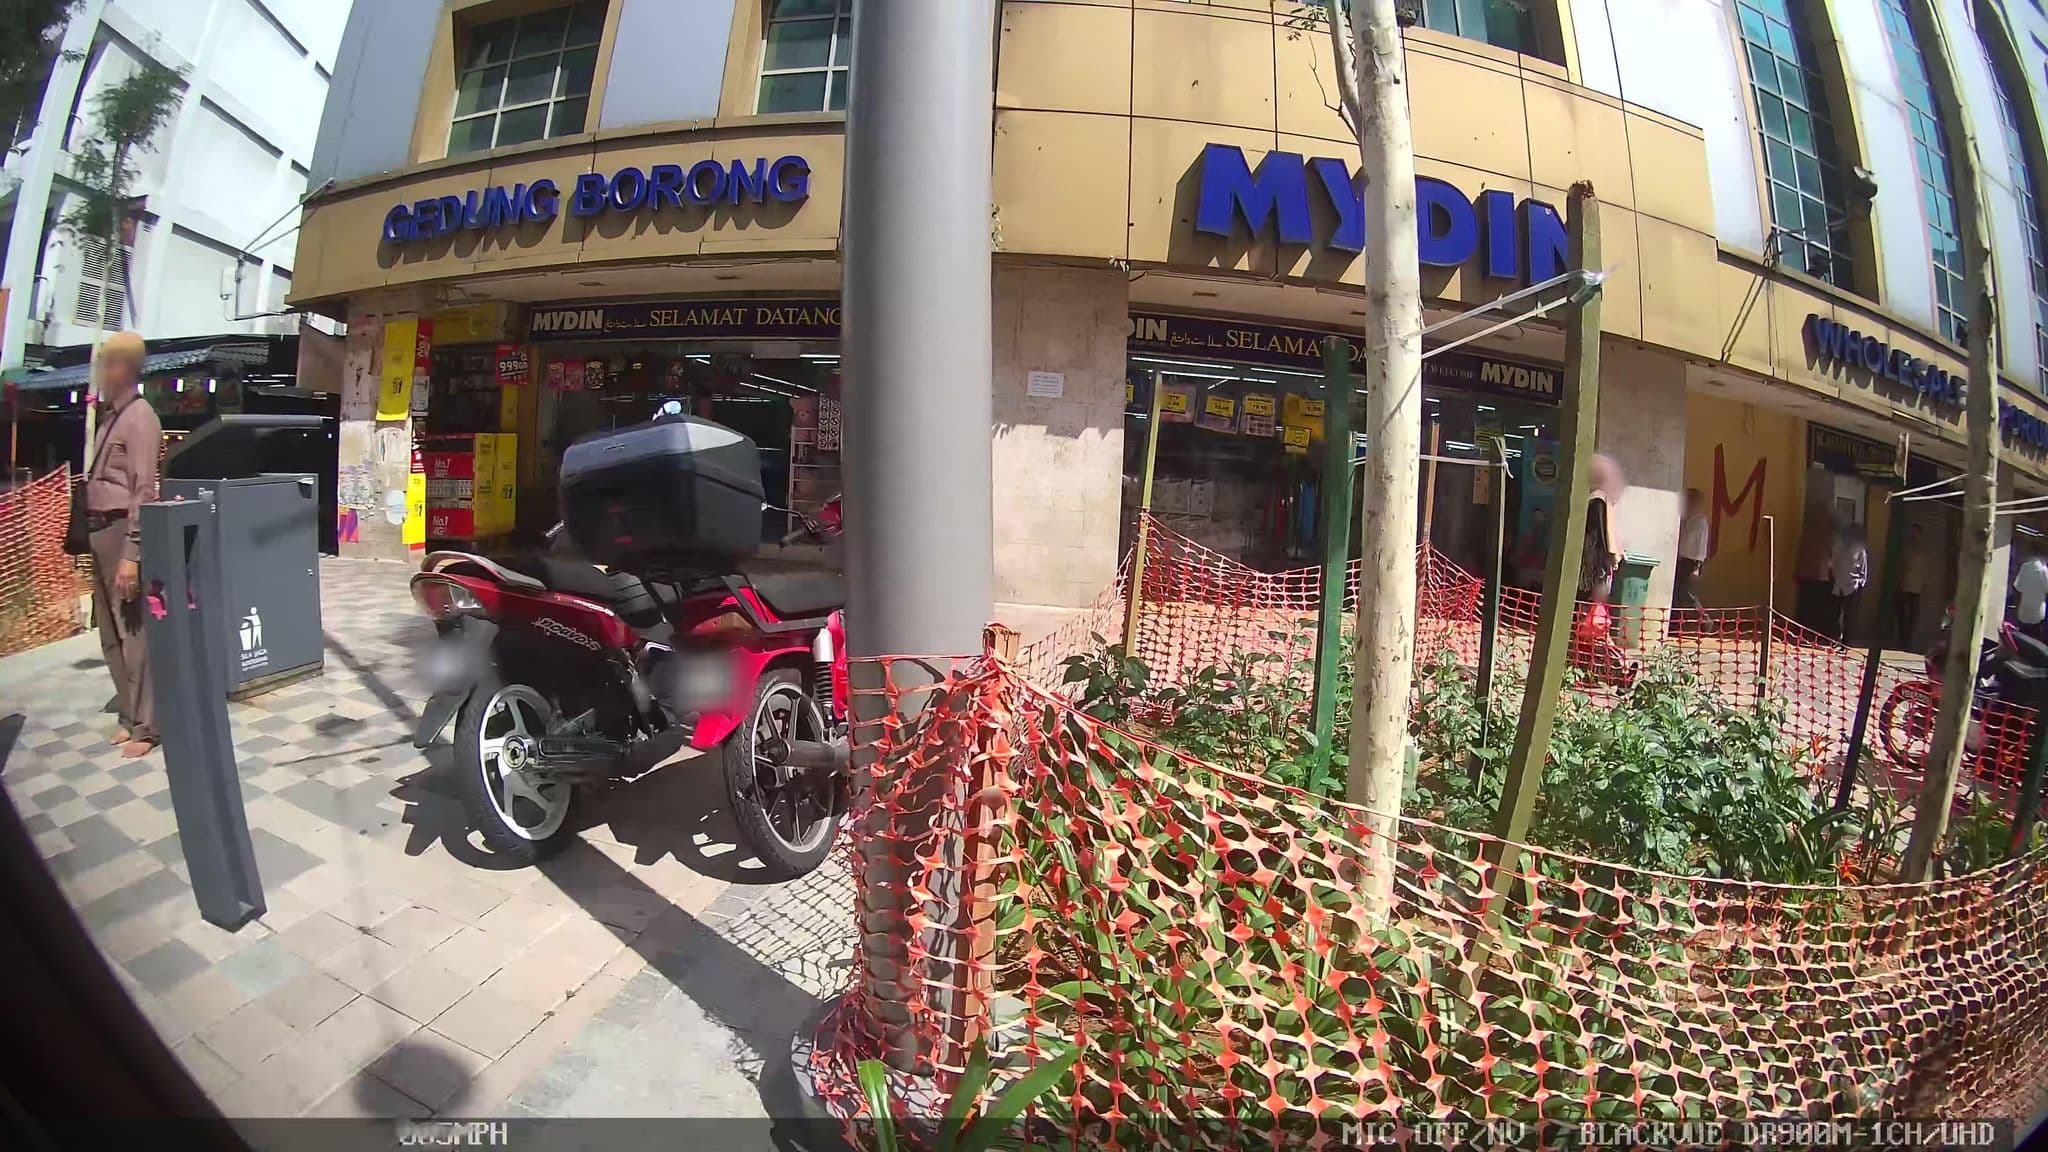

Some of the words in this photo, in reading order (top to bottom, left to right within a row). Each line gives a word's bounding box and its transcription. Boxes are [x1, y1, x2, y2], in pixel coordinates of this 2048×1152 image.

[383, 178, 560, 243] GEDUNG
[571, 155, 811, 217] BORONG
[532, 309, 604, 332] MYDIN
[650, 307, 748, 327] SELAMAT
[756, 306, 842, 326] DATANG
[1226, 328, 1324, 359] SELAMA
[1480, 361, 1554, 394] MYDIN
[432, 515, 449, 527] No.1
